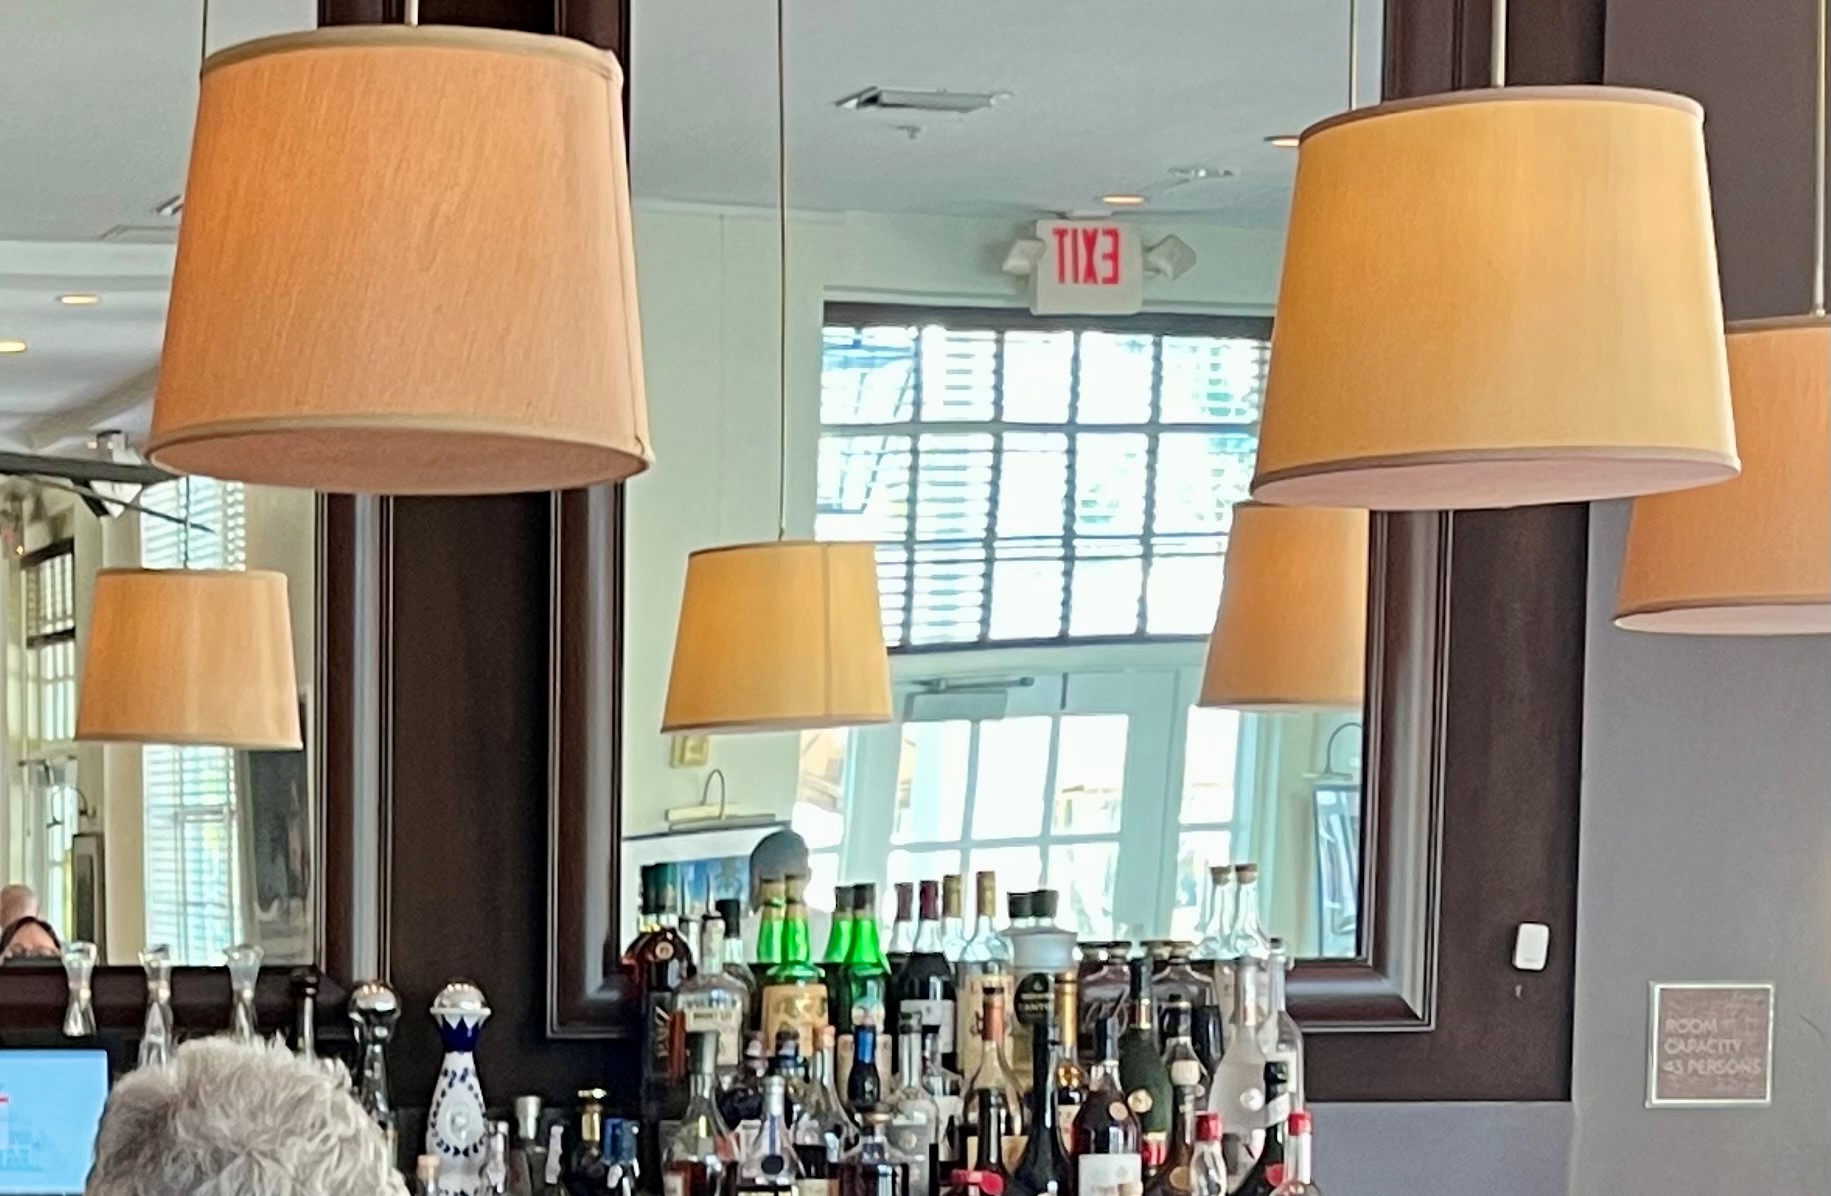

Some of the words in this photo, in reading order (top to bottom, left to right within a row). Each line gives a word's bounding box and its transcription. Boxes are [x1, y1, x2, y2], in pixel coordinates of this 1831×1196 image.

[1665, 1018, 1718, 1033] ROOM
[1663, 1038, 1742, 1054] CAPACITY
[1687, 1059, 1763, 1075] PERSONS
